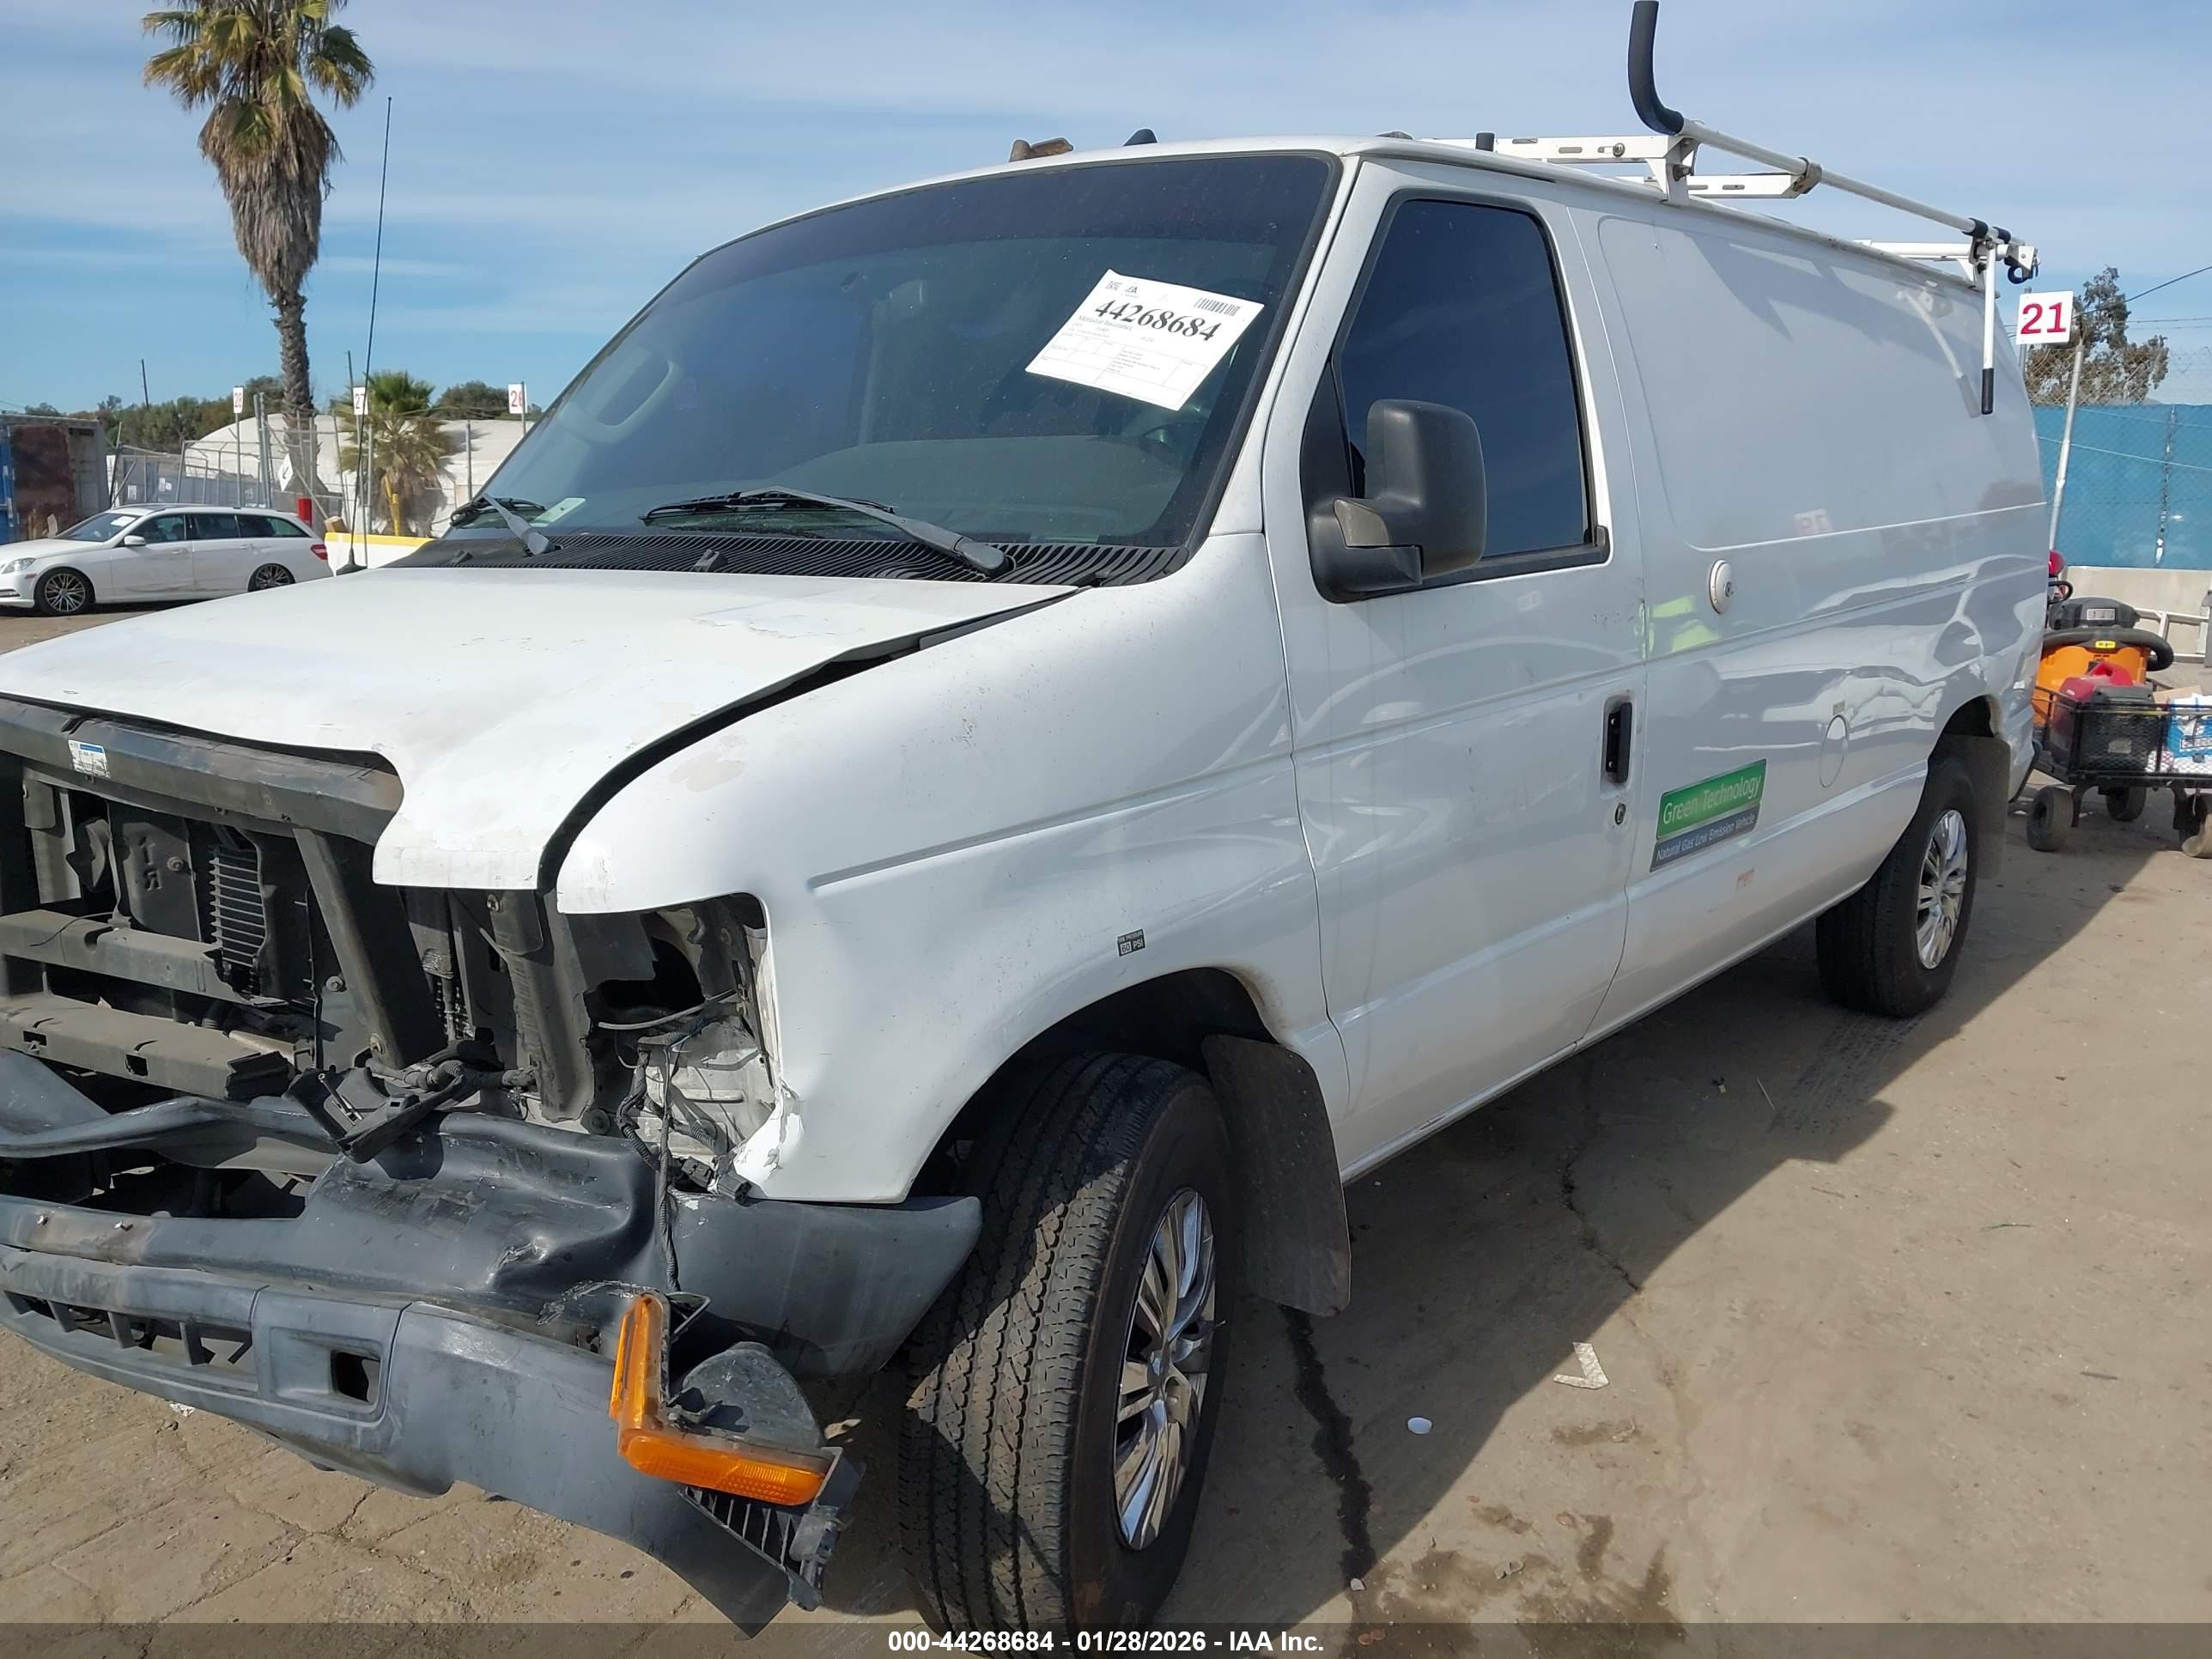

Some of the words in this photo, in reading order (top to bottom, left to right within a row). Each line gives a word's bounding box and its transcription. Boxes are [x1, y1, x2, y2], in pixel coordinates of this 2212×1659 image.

[1094, 300, 1223, 342] 44268684
[2020, 302, 2067, 334] 21
[1662, 799, 1698, 824] Green
[1703, 775, 1761, 810] Technology
[1656, 842, 1680, 861] Natural
[1681, 837, 1695, 851] Gas
[1695, 833, 1709, 847] Low
[1709, 822, 1735, 841] Emission
